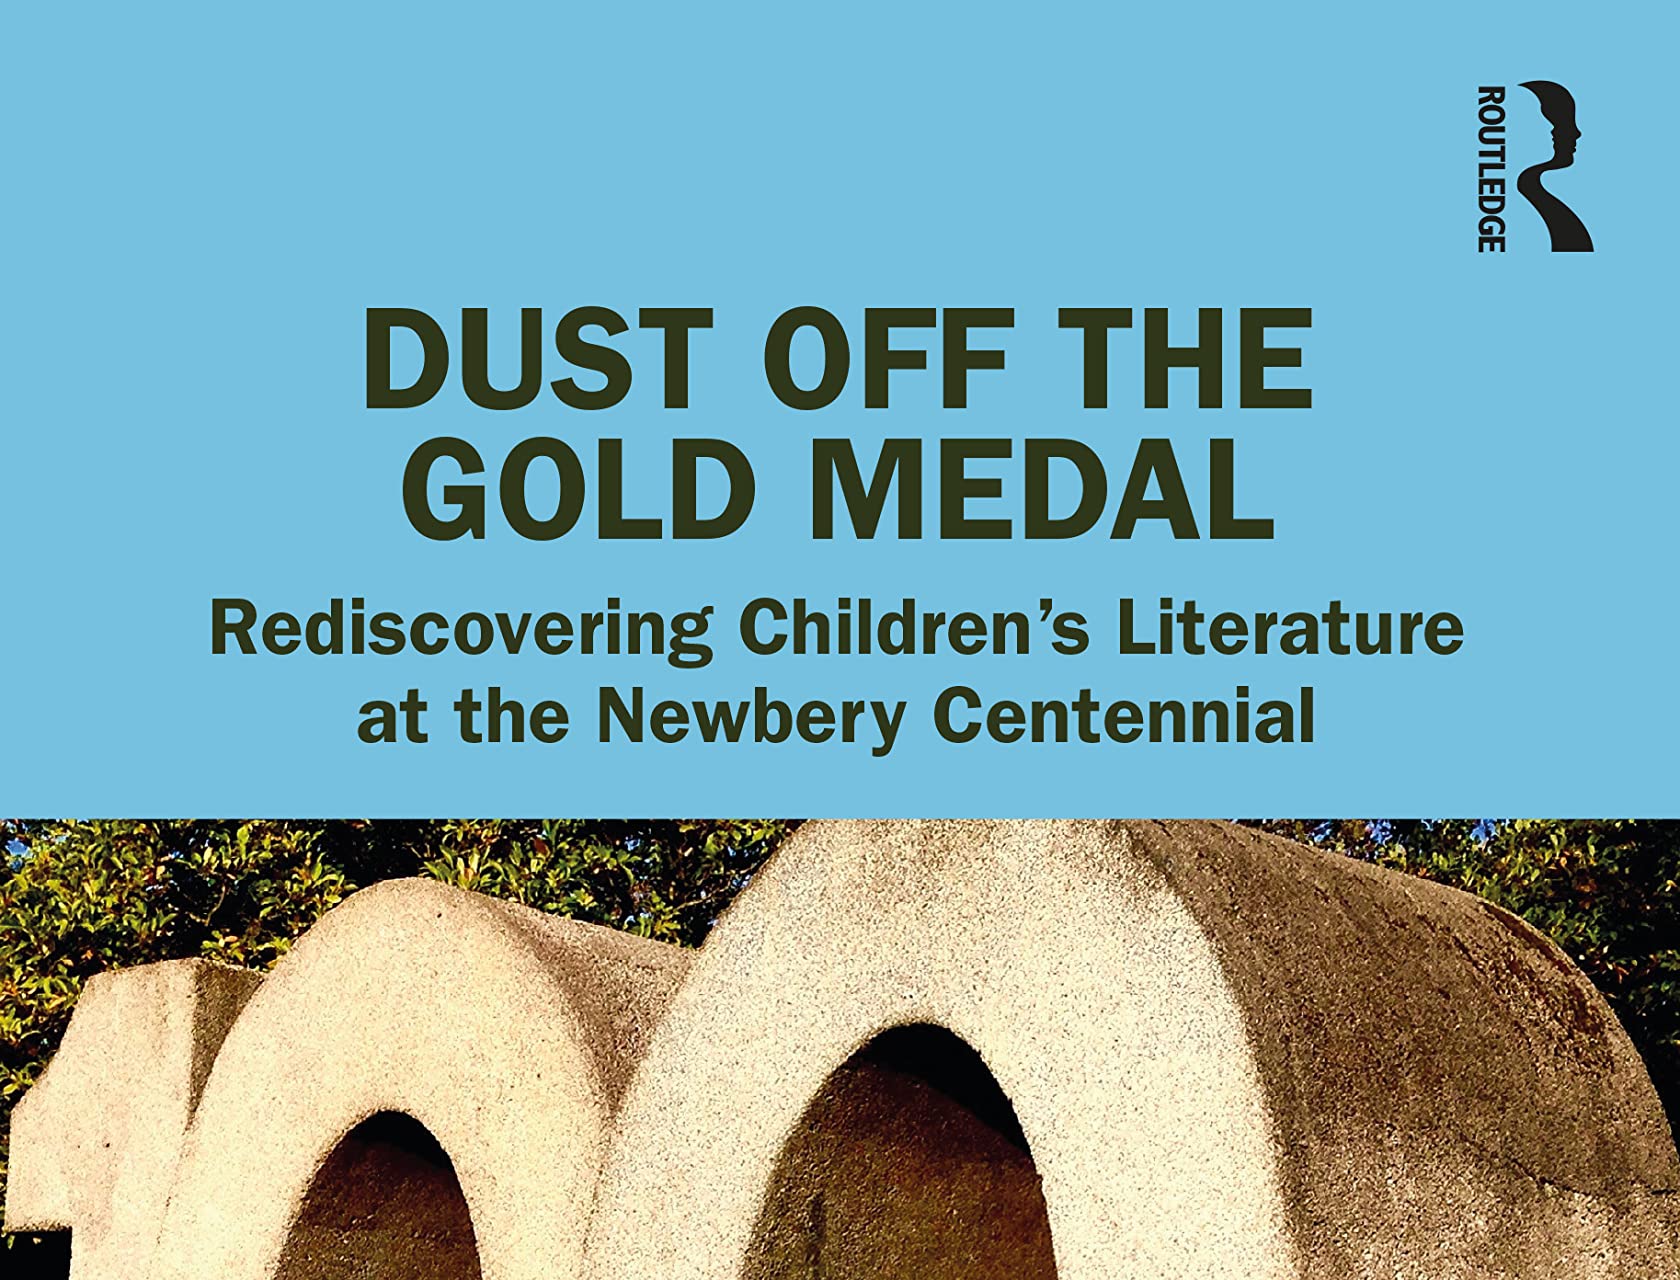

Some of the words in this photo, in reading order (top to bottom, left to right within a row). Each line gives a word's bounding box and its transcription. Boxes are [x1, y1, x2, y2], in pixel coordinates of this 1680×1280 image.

[1478, 86, 1506, 253] ROUTLEDGE
[366, 306, 713, 410] DUST
[764, 306, 1014, 410] OFF
[1058, 308, 1312, 408] THE
[403, 437, 755, 541] GOLD
[813, 438, 1274, 539] MEDAL
[212, 598, 714, 669] Rediscovering
[740, 598, 1089, 655] Children’s
[1120, 598, 1464, 655] Literature
[358, 689, 428, 743] at
[454, 687, 569, 743] the
[600, 687, 907, 757] Newbery
[934, 686, 1313, 743] Centennial
